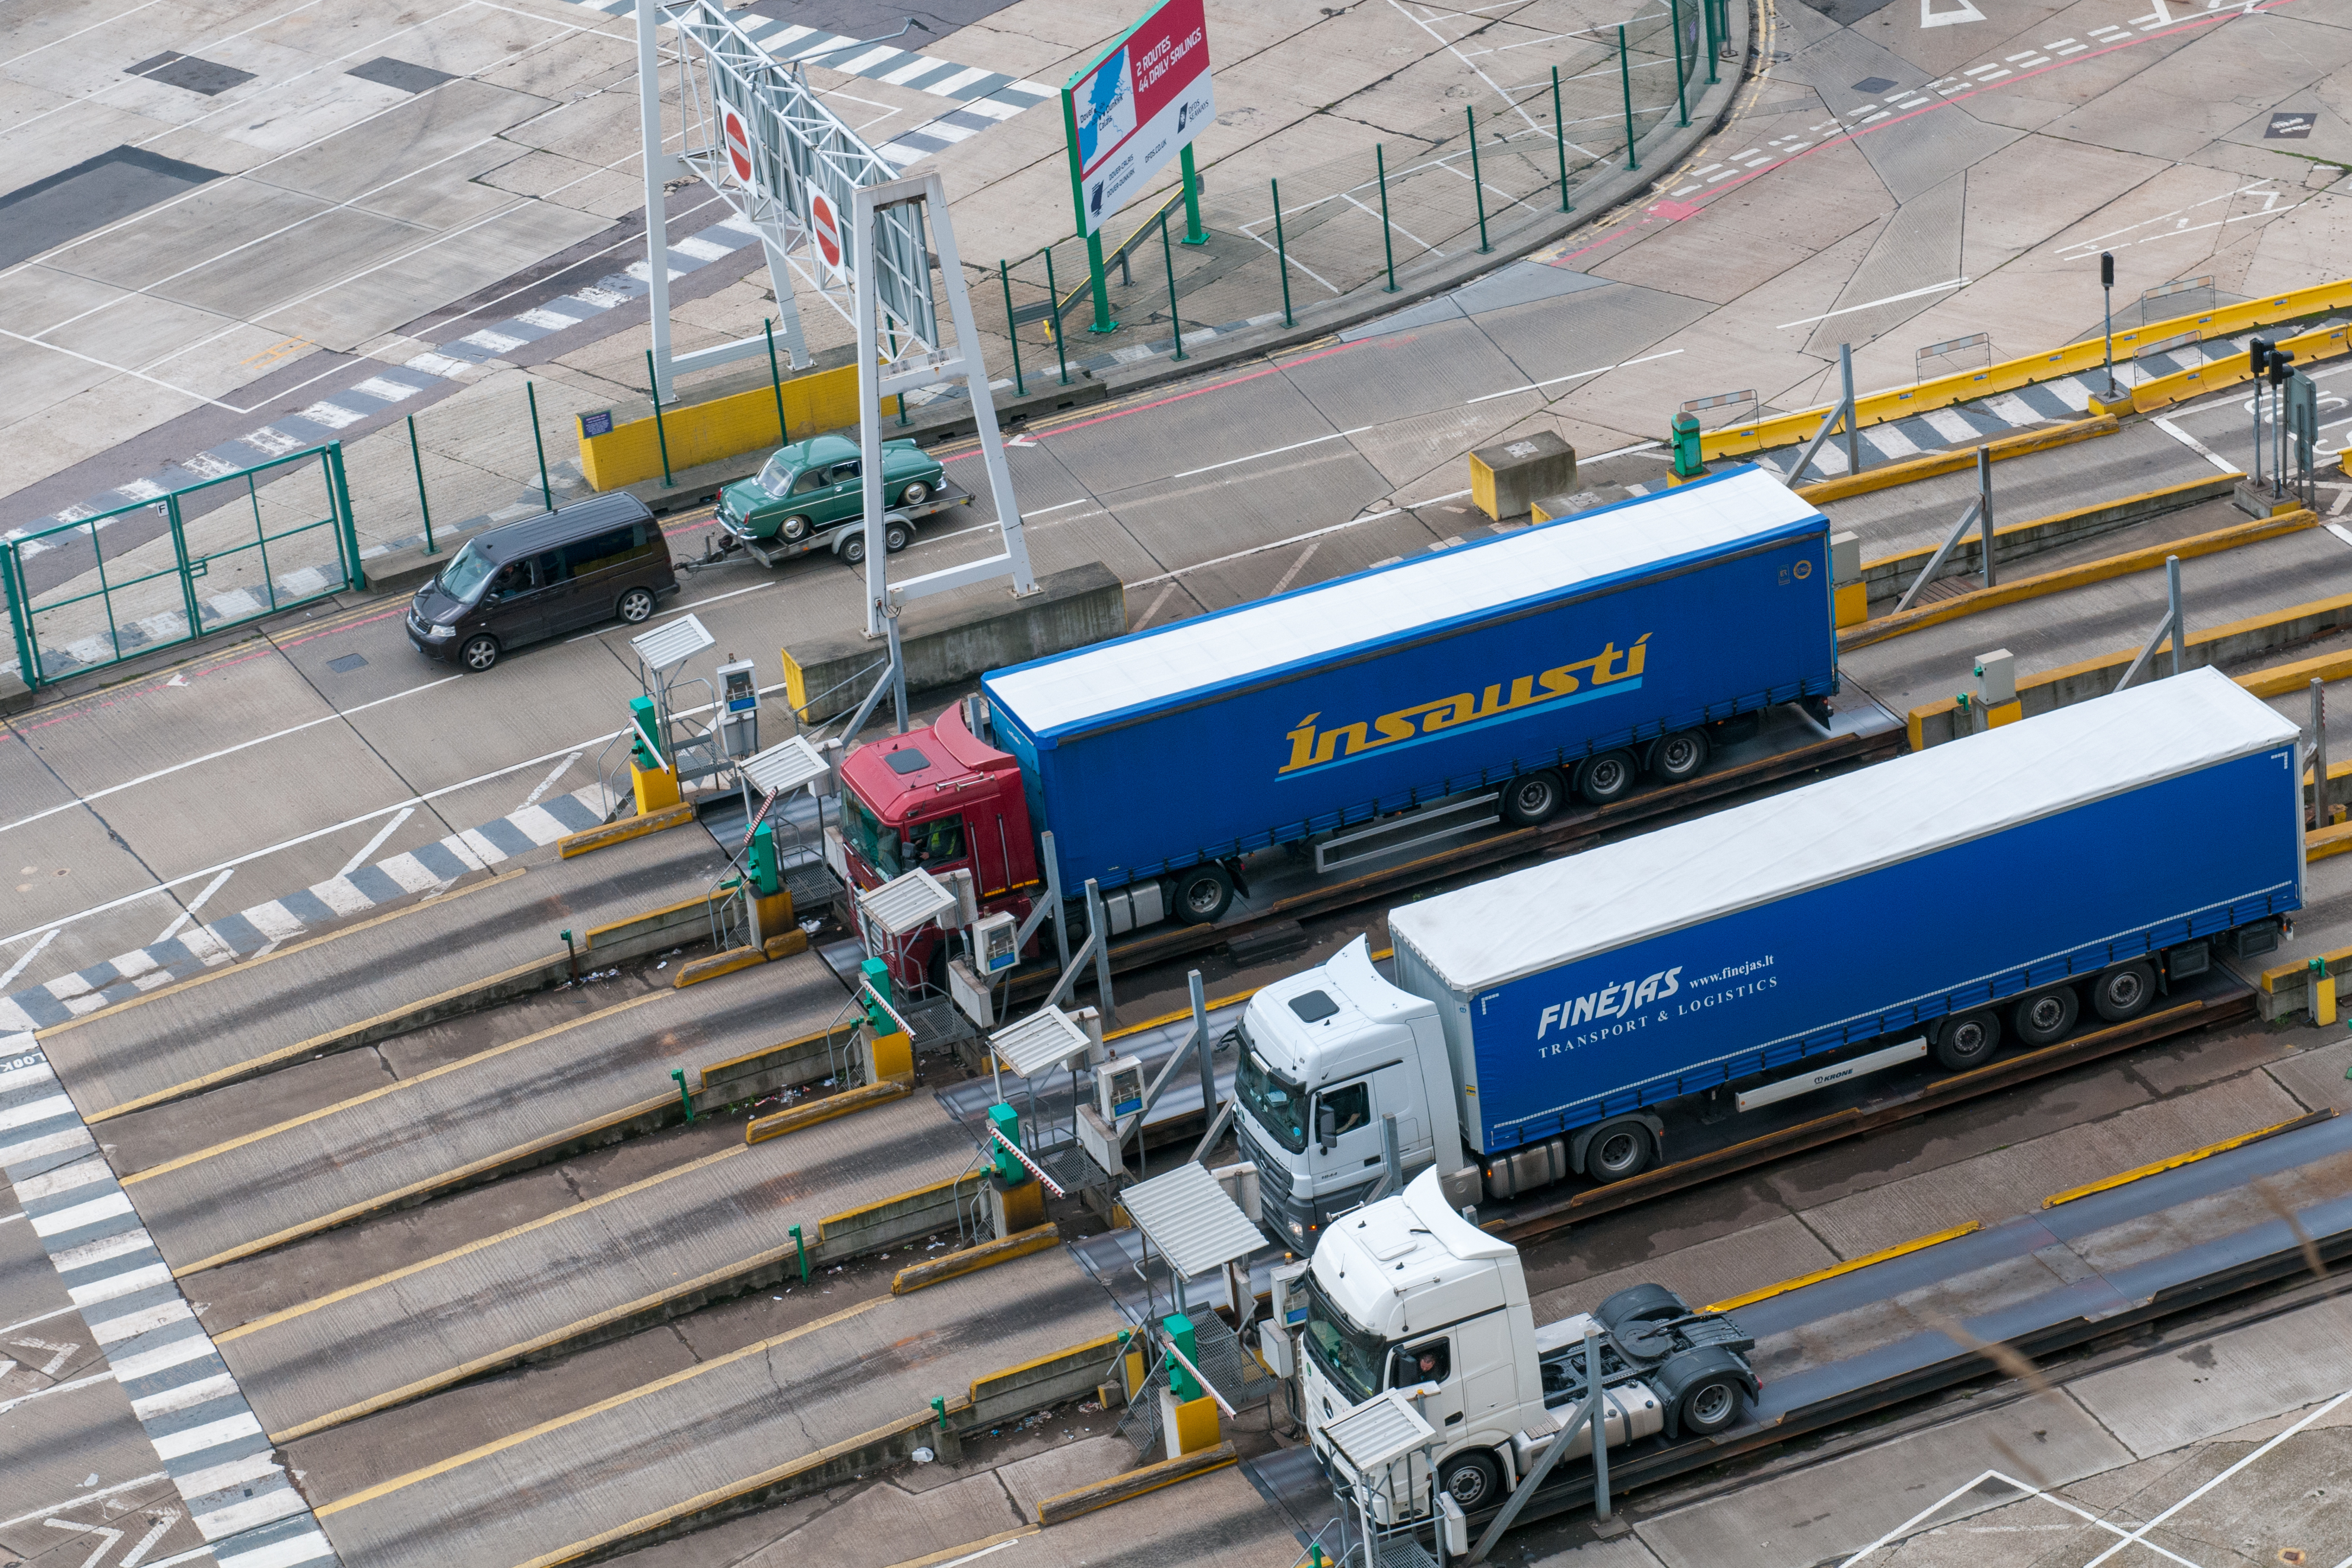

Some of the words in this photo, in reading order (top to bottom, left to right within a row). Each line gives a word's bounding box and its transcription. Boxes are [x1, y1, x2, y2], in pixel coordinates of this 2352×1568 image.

[1136, 61, 1142, 77] 2
[1142, 35, 1171, 71] ROUTES
[1139, 75, 1149, 93] 44
[1149, 55, 1169, 85] DAILY
[1170, 27, 1202, 66] SAILINGS
[1080, 107, 1093, 123] Dover
[1106, 94, 1123, 114] Dunkirk
[1188, 98, 1200, 115] DFDS
[1189, 99, 1209, 122] SEAWAYS
[1099, 115, 1113, 131] Calais
[1109, 154, 1133, 181] DOVER-CALAIS
[1107, 167, 1134, 198] DOVER-DUNKIRK
[158, 504, 166, 514] F
[1689, 955, 1774, 989] www.finejas.lt
[1538, 1016, 1648, 1058] TRANSPORT
[1657, 1010, 1668, 1022] &
[1678, 977, 1778, 1016] LOGISTICS
[0, 1052, 47, 1072] LOOK
[1823, 1068, 1853, 1082] KRONE
